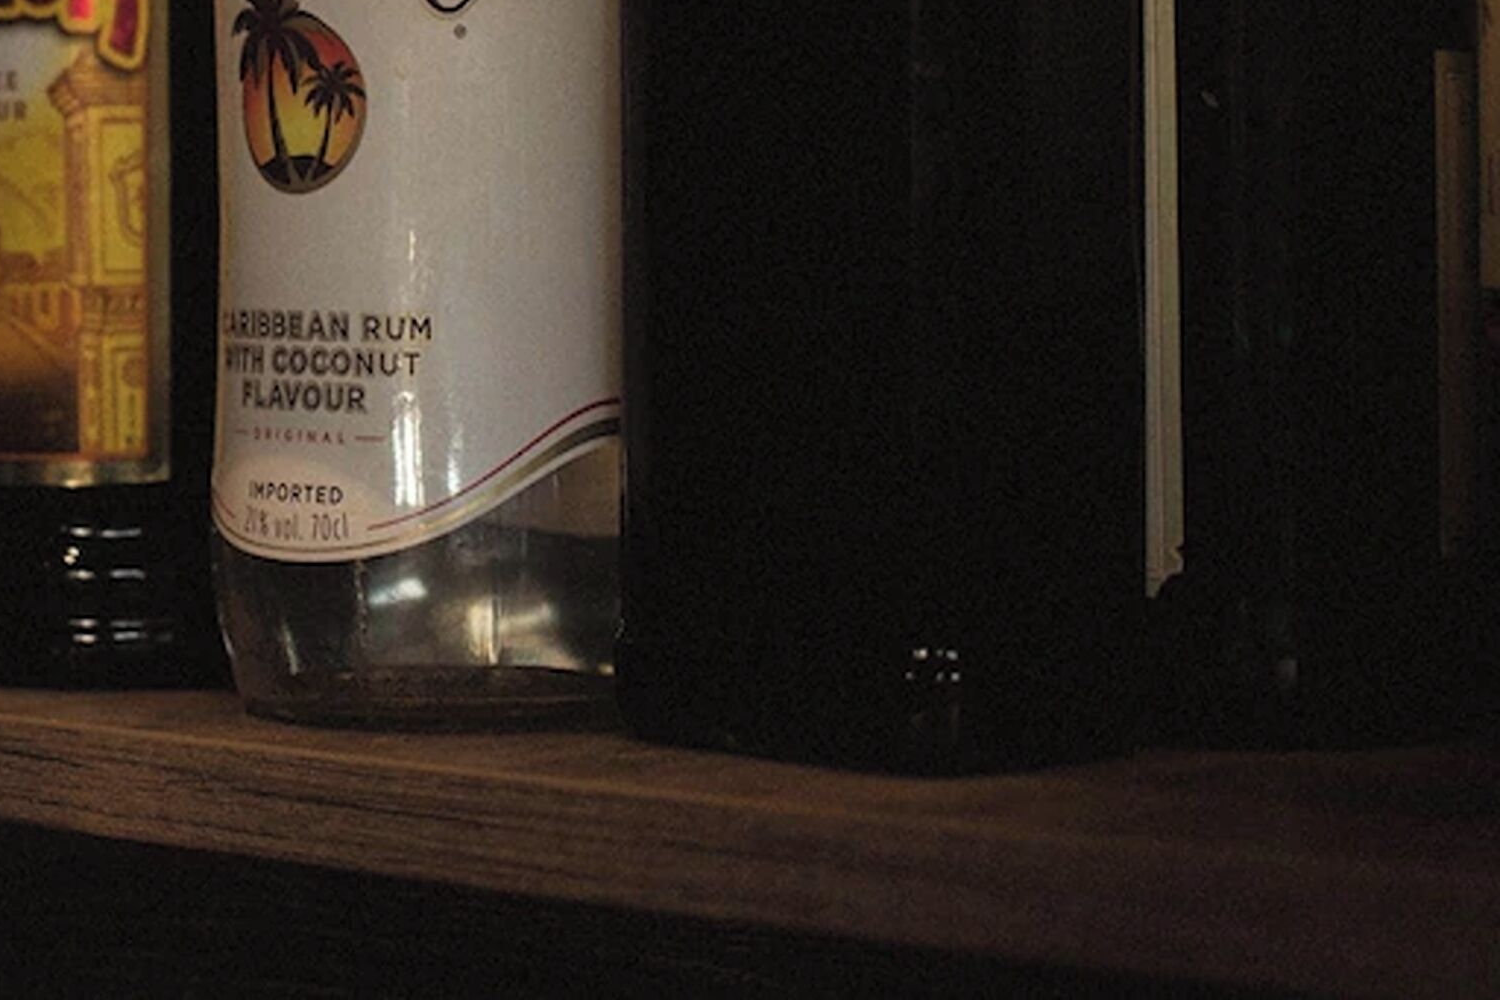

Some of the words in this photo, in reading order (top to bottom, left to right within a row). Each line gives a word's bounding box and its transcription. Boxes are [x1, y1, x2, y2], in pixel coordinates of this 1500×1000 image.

[362, 314, 432, 341] RUM
[271, 348, 421, 377] COCONUT
[242, 379, 367, 413] FLAVOUR
[254, 427, 345, 445] ORIGINAL
[248, 480, 344, 505] IMPORTED
[311, 511, 350, 542] 70cl
